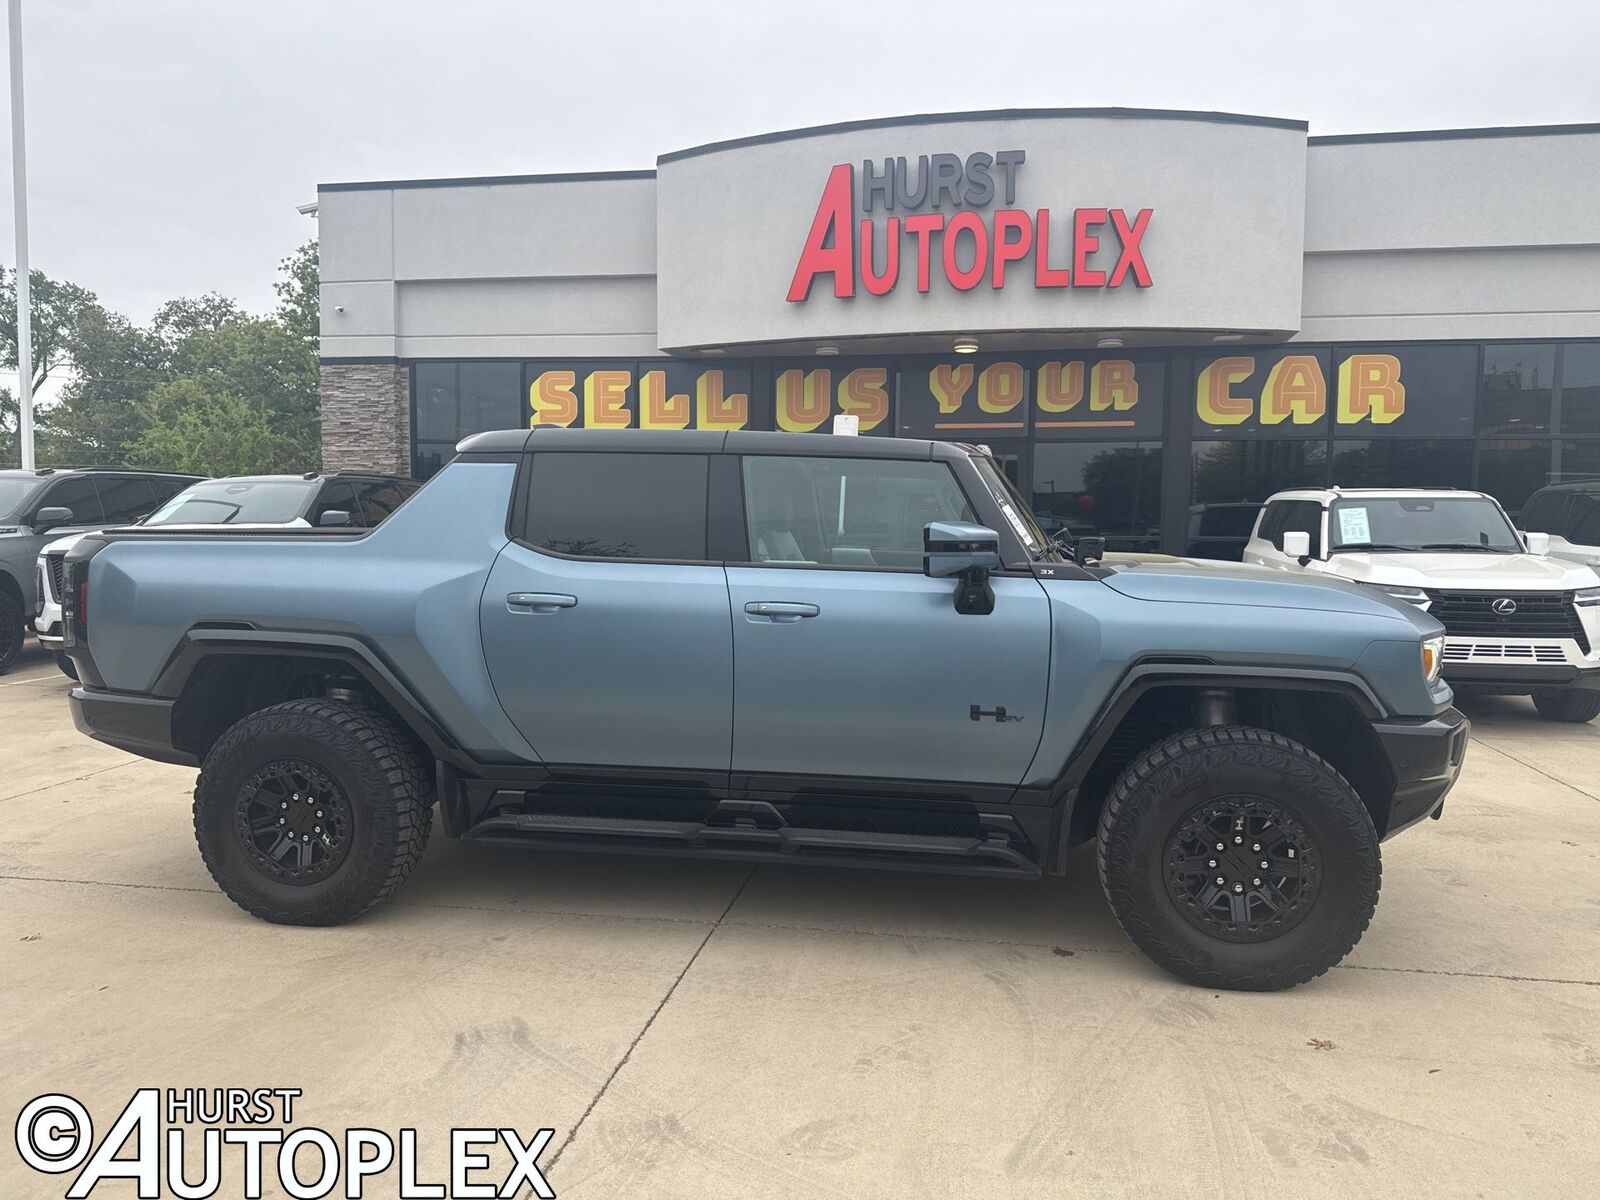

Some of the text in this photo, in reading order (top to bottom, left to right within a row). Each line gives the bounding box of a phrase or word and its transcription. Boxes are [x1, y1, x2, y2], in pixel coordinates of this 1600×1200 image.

[863, 150, 1026, 213] HURST
[786, 163, 1154, 302] AUTOPLEX
[530, 354, 1406, 433] SELL US YOUR CAR
